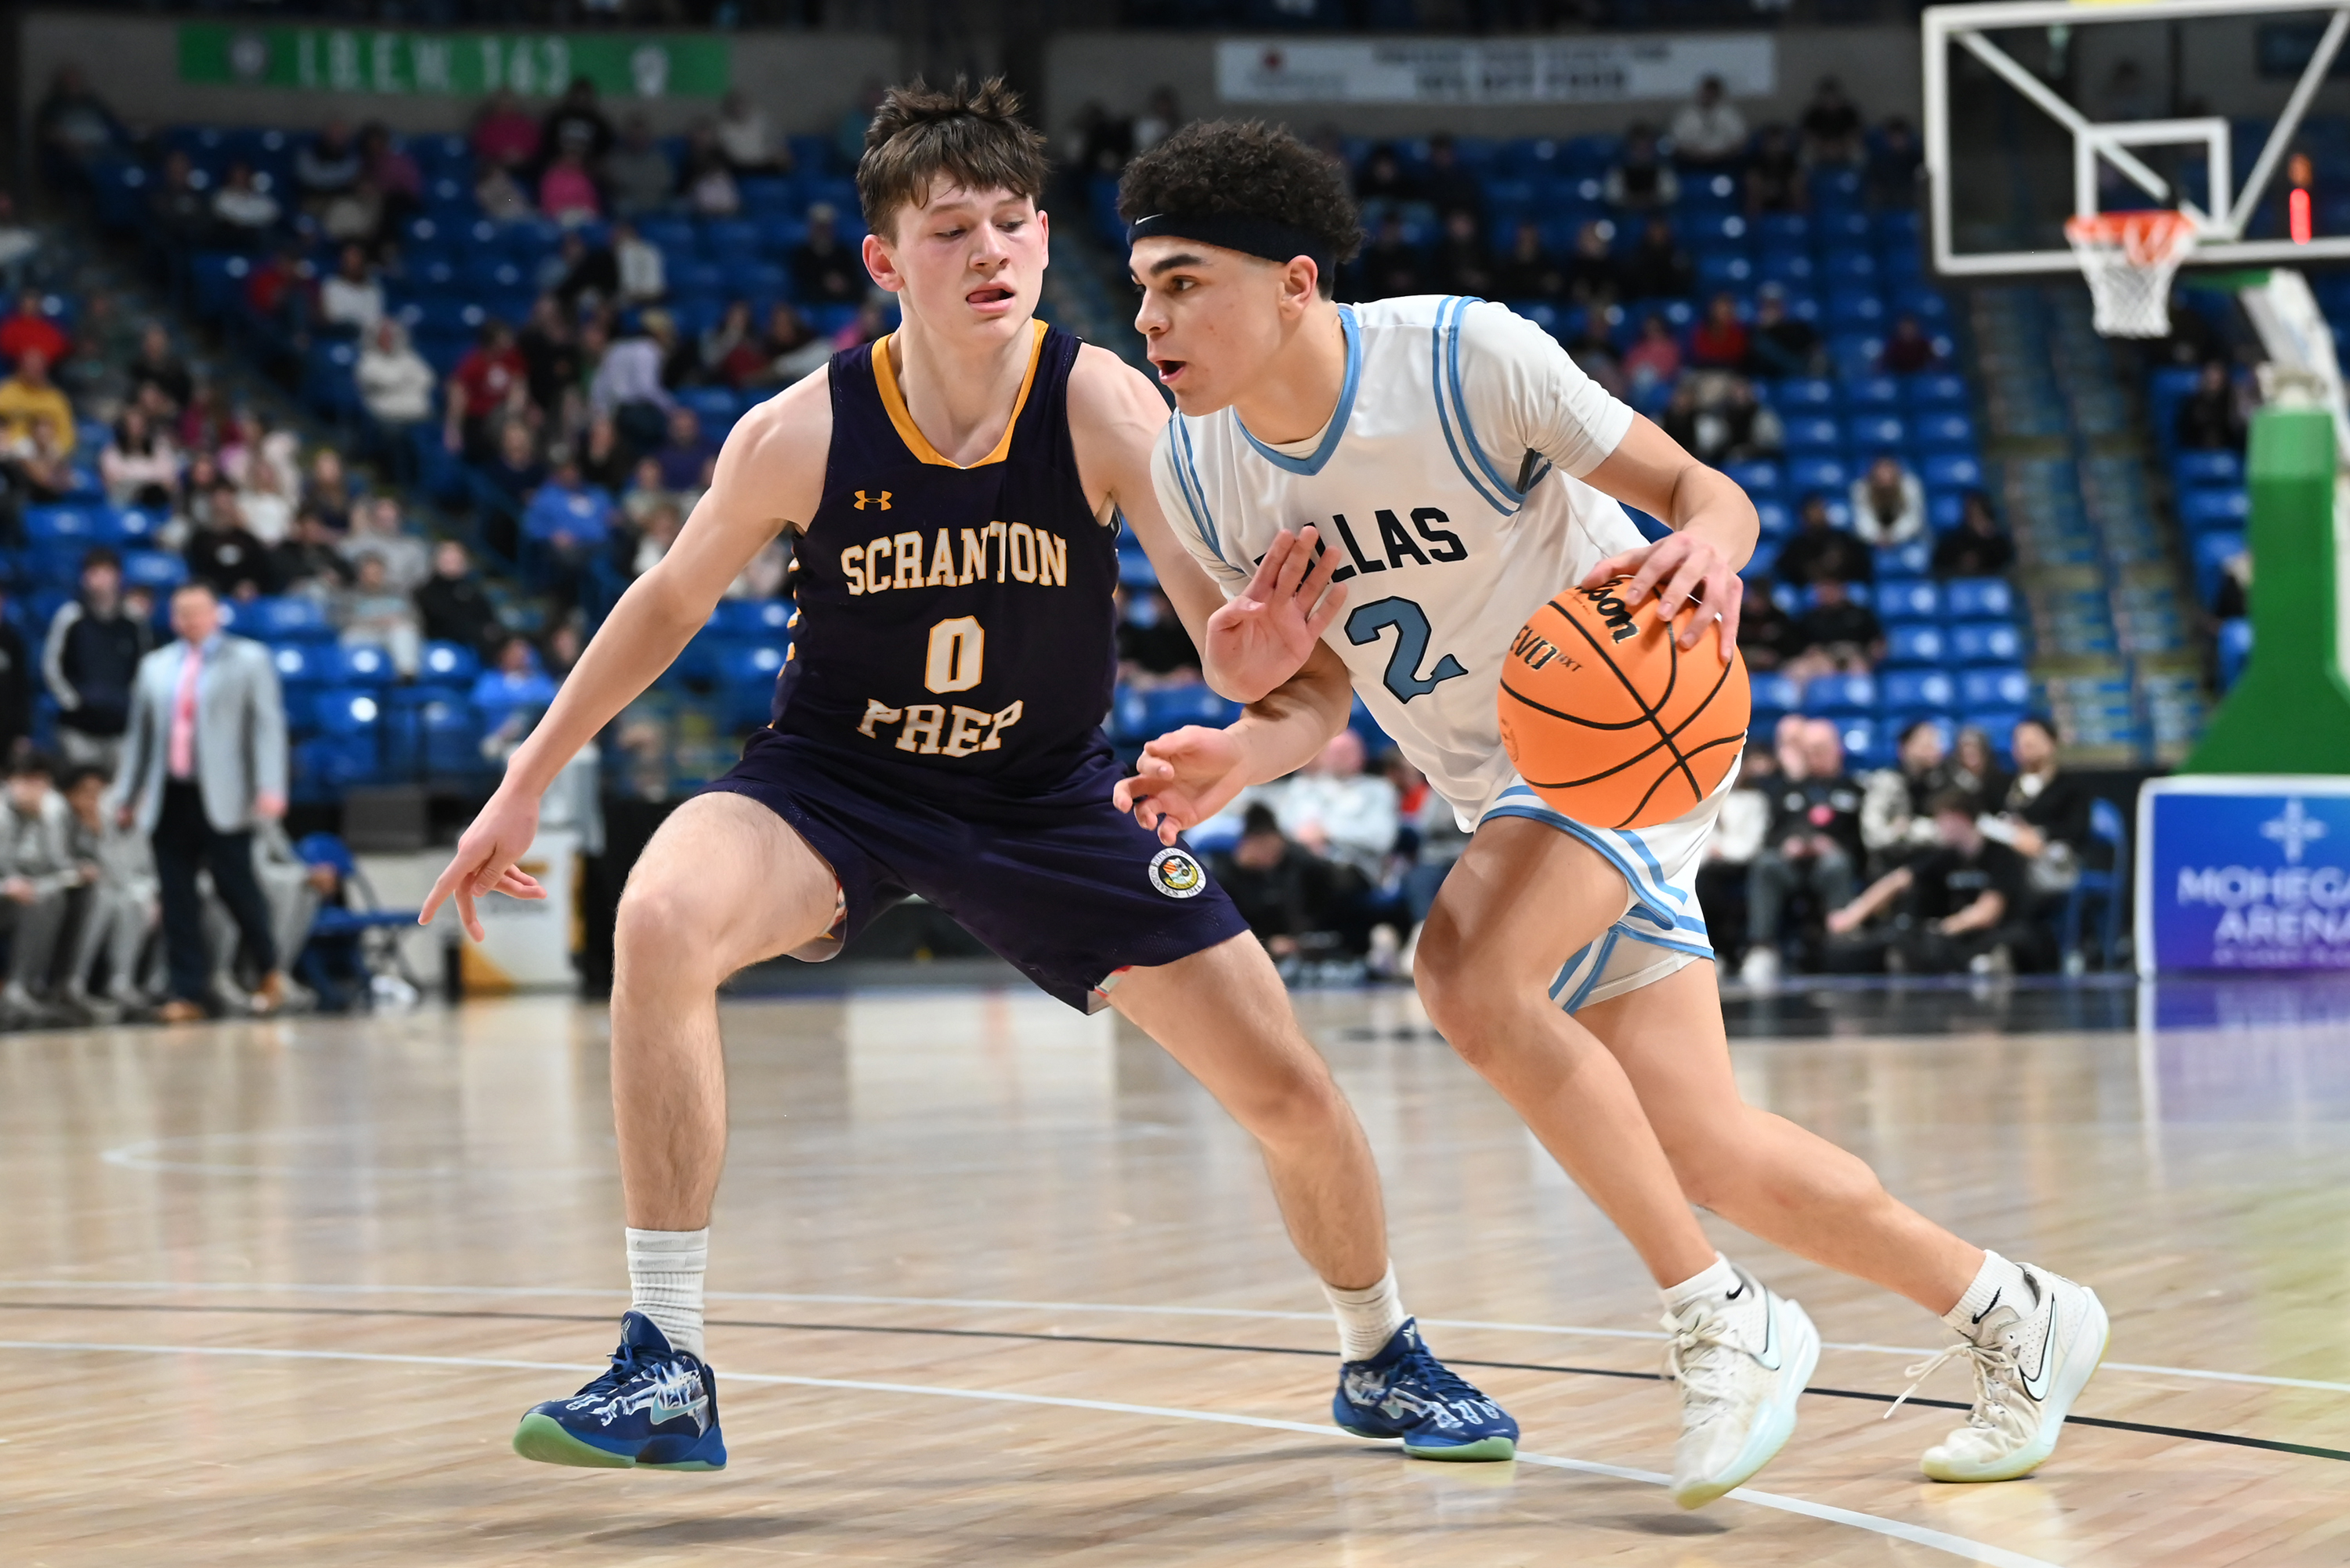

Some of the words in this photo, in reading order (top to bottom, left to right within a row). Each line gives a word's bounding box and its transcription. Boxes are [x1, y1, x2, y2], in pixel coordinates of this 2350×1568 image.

[841, 521, 1068, 596] SCRANTON
[1253, 508, 1468, 593] LLAS
[924, 615, 985, 695] 0
[1344, 595, 1469, 705] 2
[856, 698, 1024, 758] PREP
[2178, 865, 2350, 907] MOHEG
